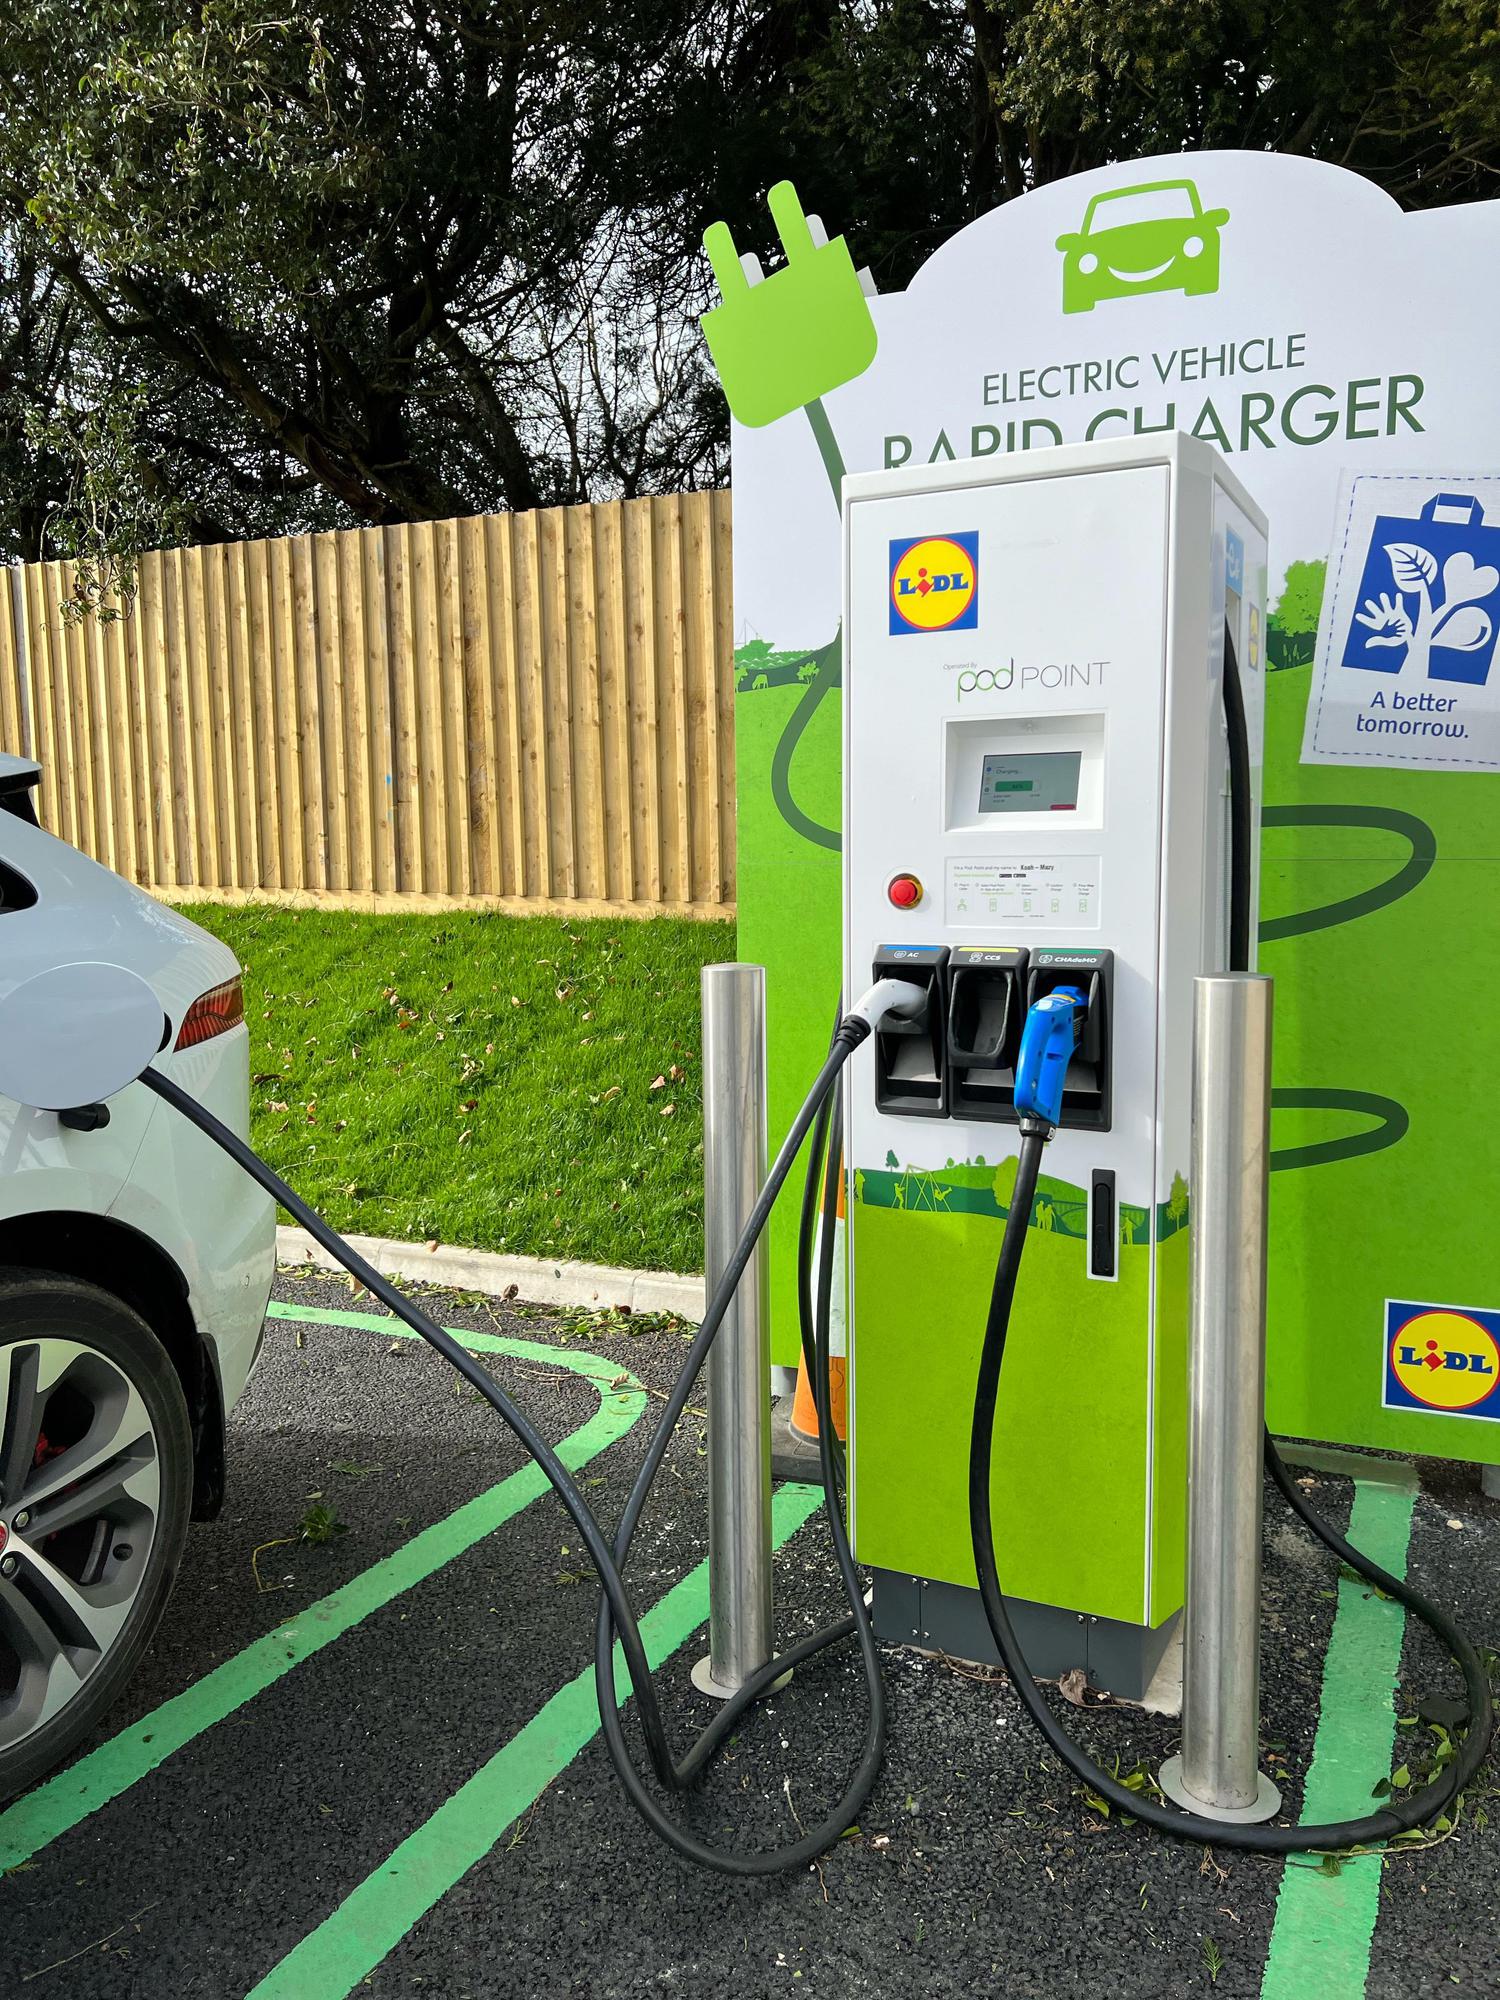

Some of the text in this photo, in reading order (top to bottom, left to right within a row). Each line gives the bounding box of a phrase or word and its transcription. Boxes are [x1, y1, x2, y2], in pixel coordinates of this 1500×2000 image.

[983, 333, 1306, 406] ELECTRIC VEHICLE
[1085, 374, 1426, 454] CHARGER
[957, 656, 1111, 703] pod POINT
[1370, 691, 1458, 713] A better
[1356, 714, 1469, 739] tomorrow.
[1054, 956, 1097, 964] CHAdeMO
